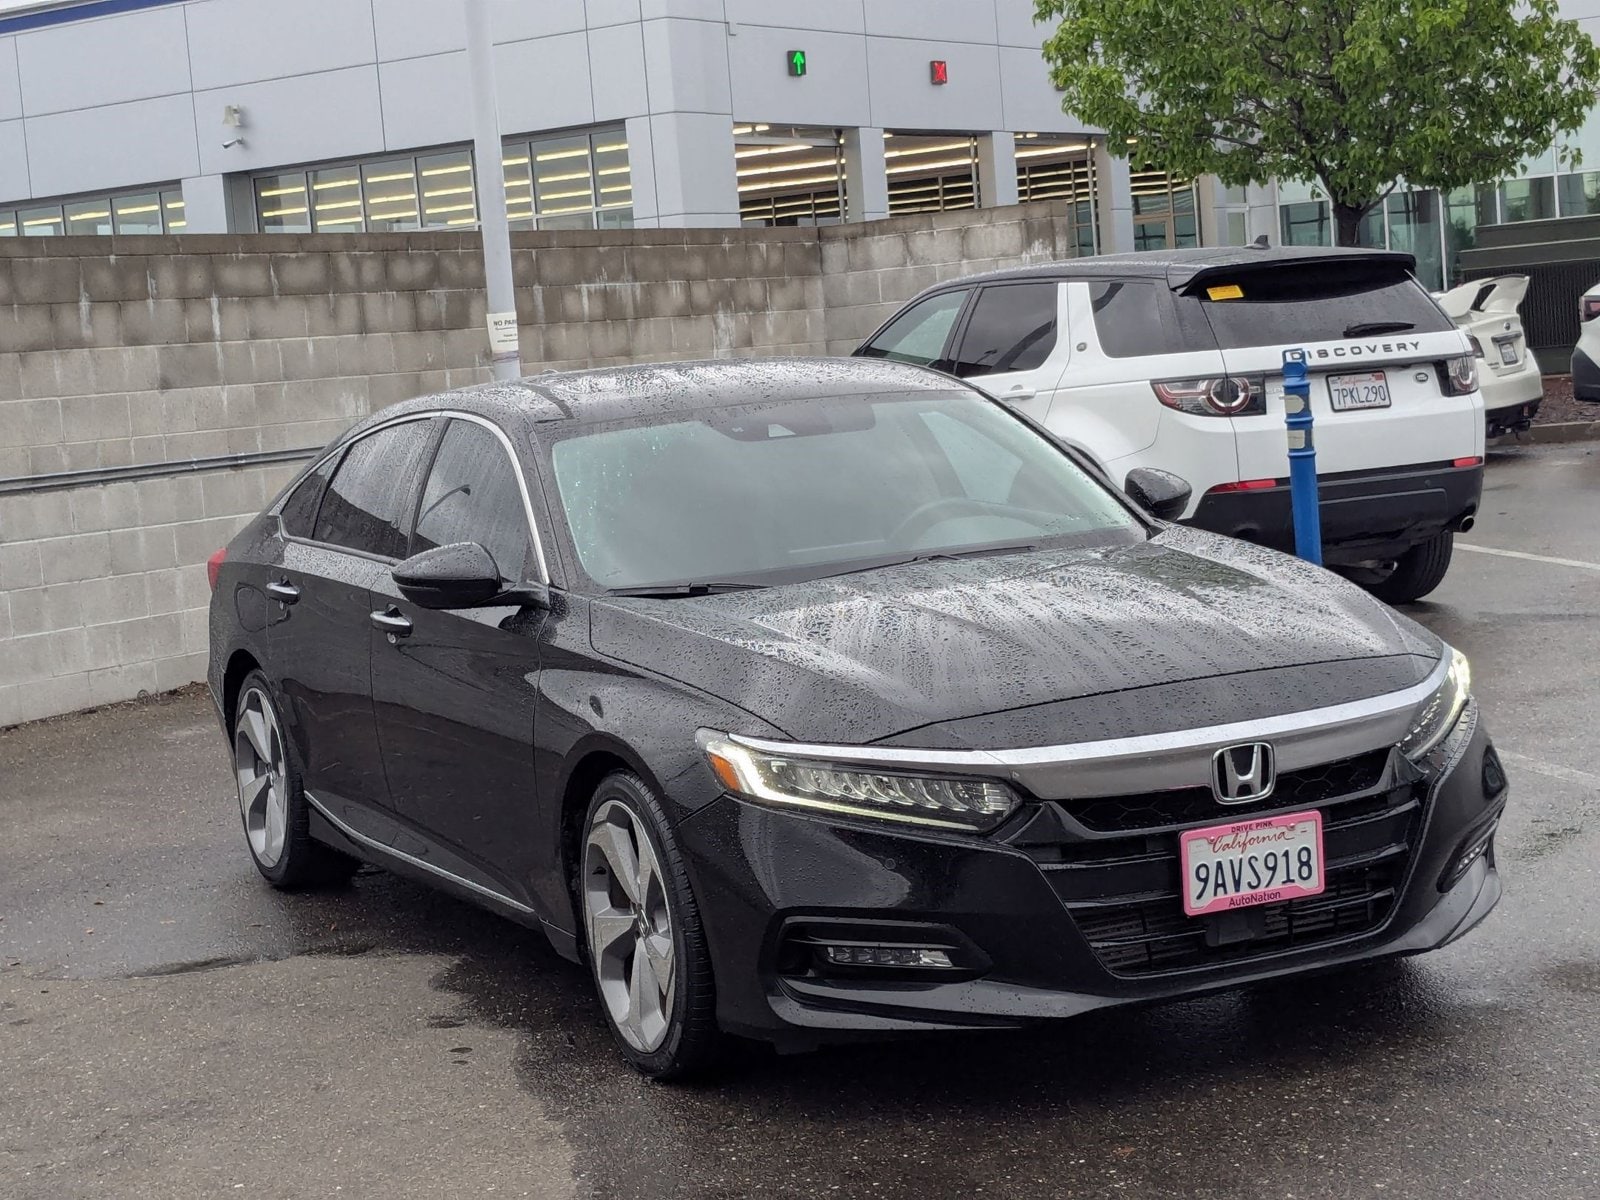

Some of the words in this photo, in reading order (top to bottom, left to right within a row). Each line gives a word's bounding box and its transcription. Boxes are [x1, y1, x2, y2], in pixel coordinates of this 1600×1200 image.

[1290, 341, 1420, 361] DISCOVERY
[1333, 385, 1387, 405] 7PKL290
[1231, 823, 1253, 833] DRIVE
[1256, 821, 1273, 829] PINK
[1212, 831, 1295, 854] California
[1195, 846, 1313, 900] 9AVS918
[1228, 890, 1281, 907] AutoNation
